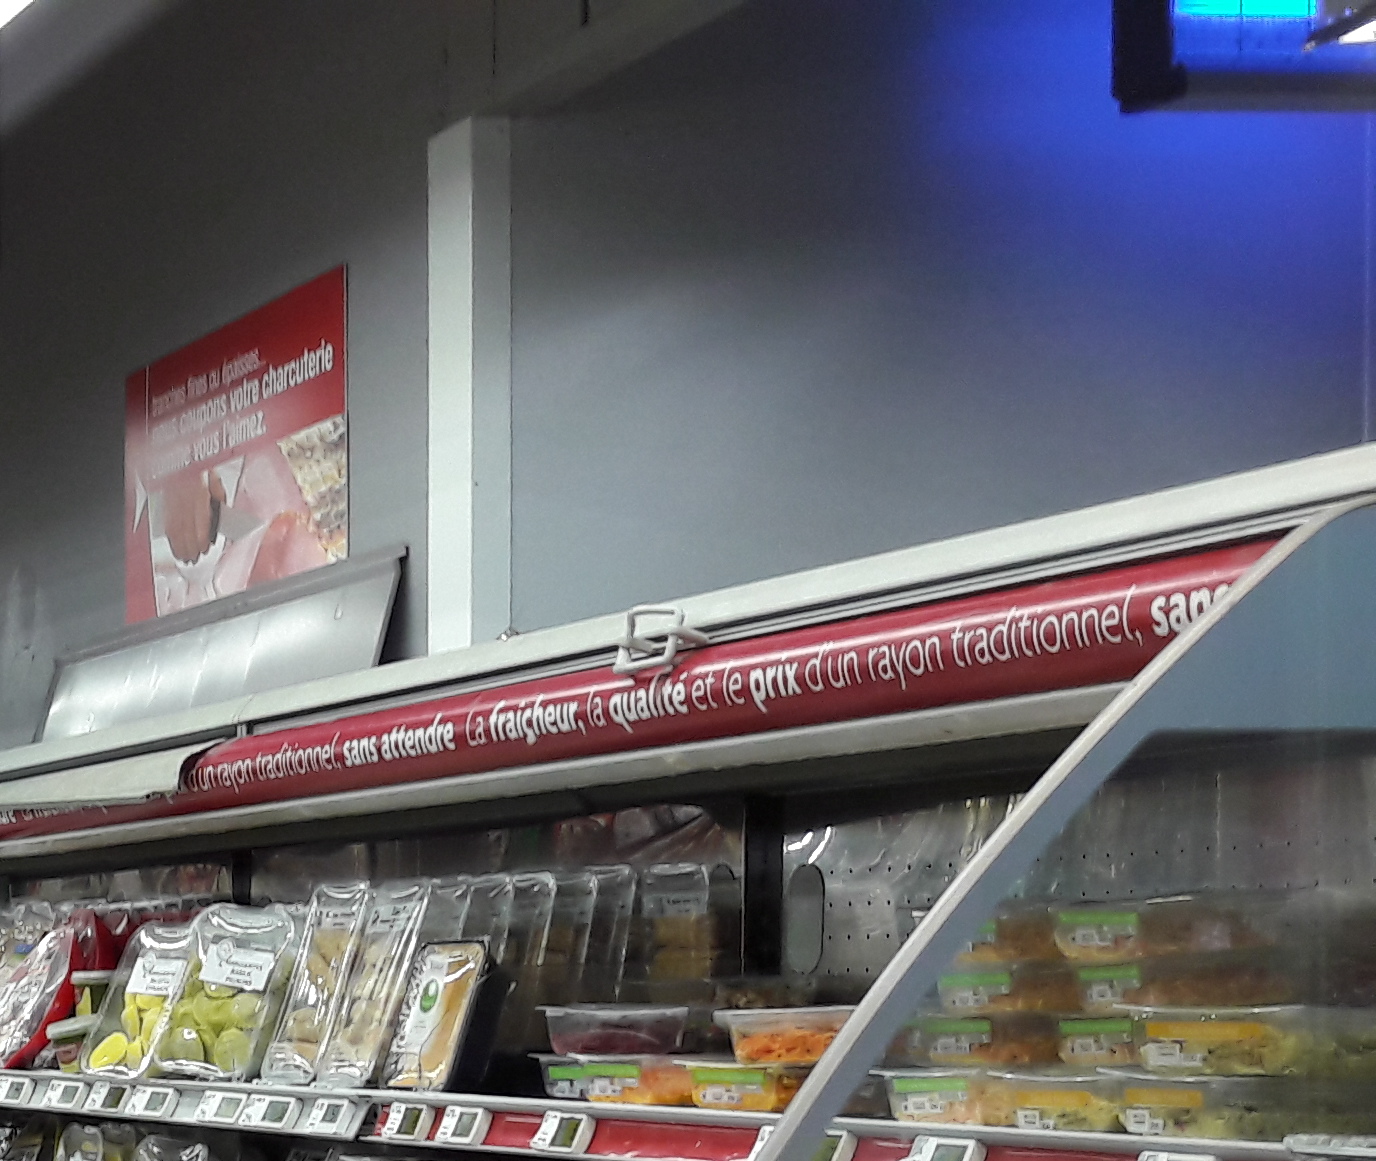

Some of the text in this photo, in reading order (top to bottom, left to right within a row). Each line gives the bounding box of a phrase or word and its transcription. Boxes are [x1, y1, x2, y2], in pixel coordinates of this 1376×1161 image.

[178, 392, 227, 435] coupons
[229, 376, 260, 413] votre
[261, 336, 334, 400] charcuterie
[192, 430, 220, 463] vous
[216, 754, 254, 794] rayon
[255, 730, 342, 783] traditionnel,
[342, 735, 378, 768] sans
[380, 710, 457, 759] attendre
[585, 687, 604, 728] la
[608, 664, 690, 735] qualité
[690, 670, 718, 712] et
[720, 661, 746, 707] le
[748, 651, 799, 714] prix
[803, 640, 861, 693] d'un
[866, 634, 944, 692] rayon
[951, 584, 1144, 670] traditionnel,
